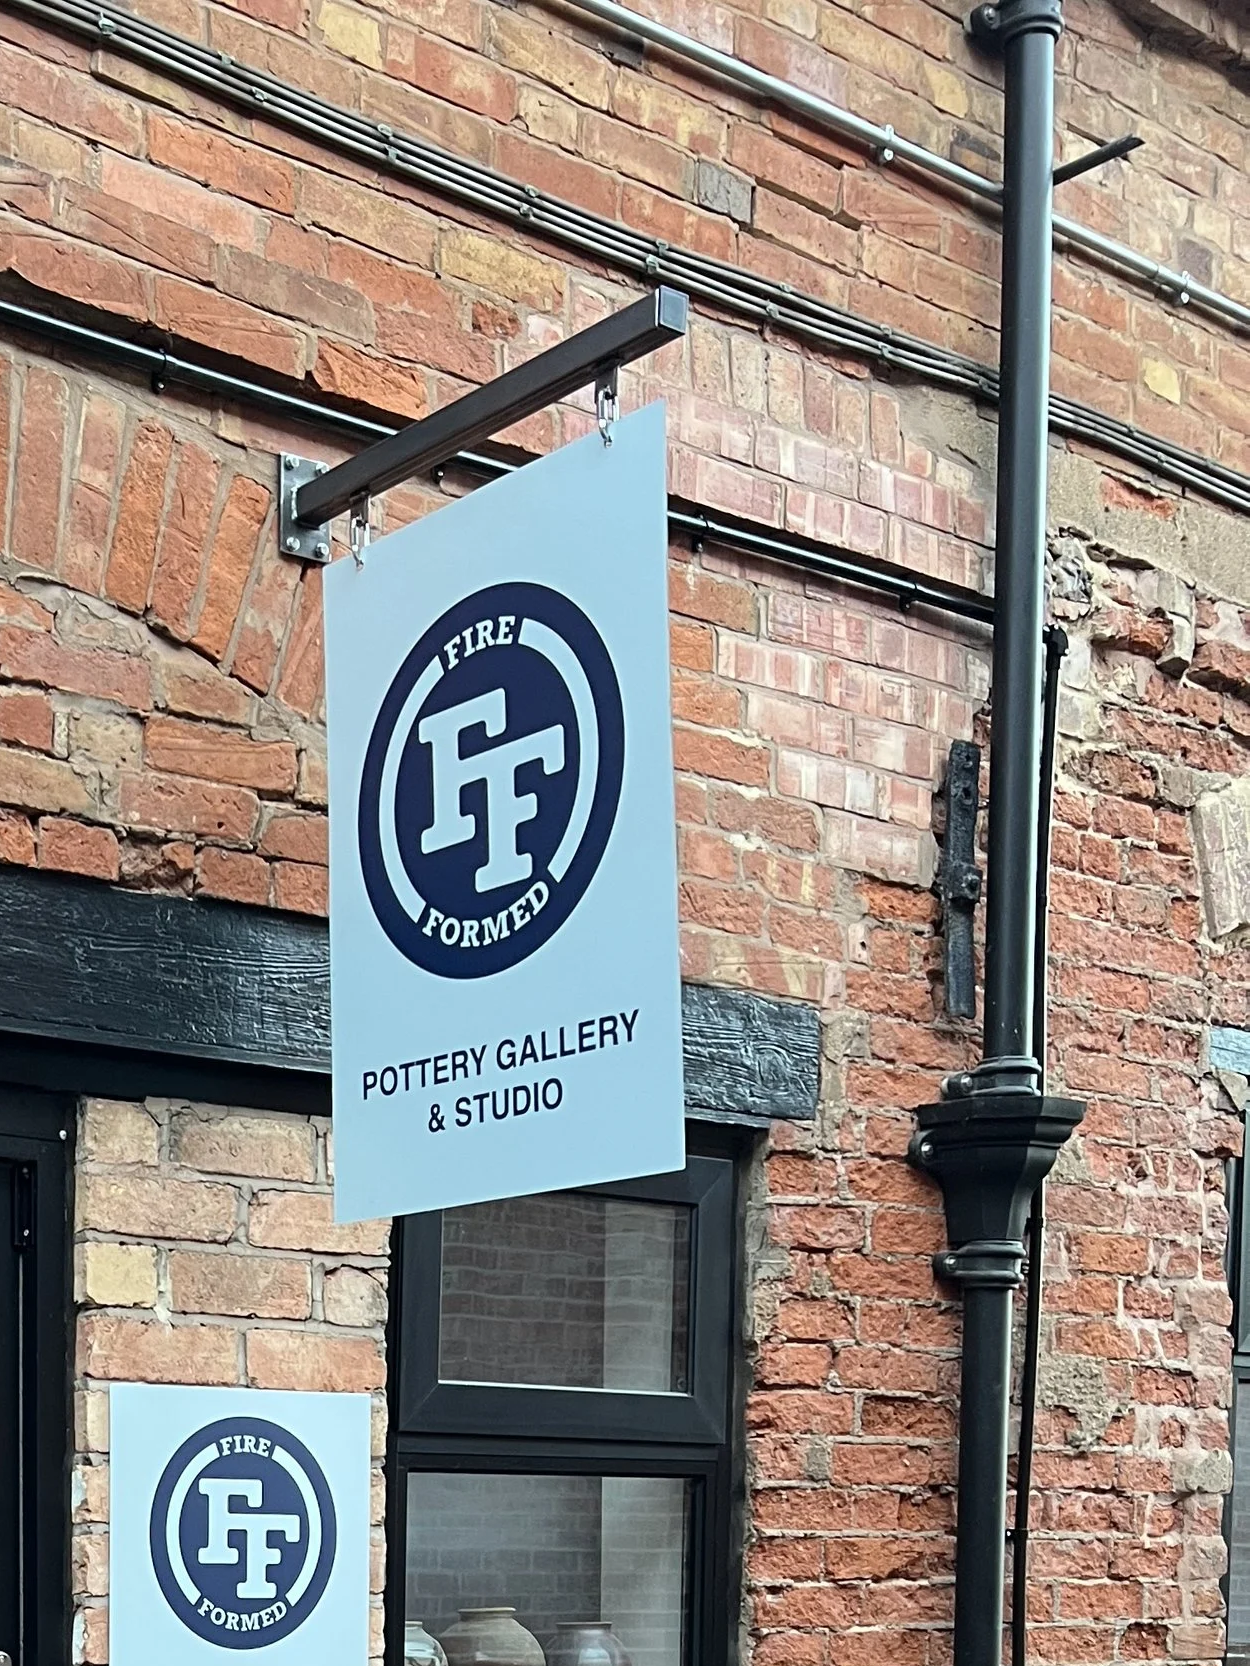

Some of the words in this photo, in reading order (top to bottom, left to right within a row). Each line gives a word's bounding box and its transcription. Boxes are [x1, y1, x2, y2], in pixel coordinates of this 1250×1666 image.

[443, 615, 516, 670] FIRE
[418, 687, 566, 894] FF
[422, 881, 550, 948] FORMED
[362, 1044, 488, 1101] POTTERY
[495, 1008, 640, 1071] GALLERY
[428, 1103, 446, 1133] &
[454, 1077, 564, 1128] STUDIO
[219, 1434, 272, 1458] FIRE
[197, 1477, 301, 1600] FF
[196, 1598, 288, 1632] FORMED
